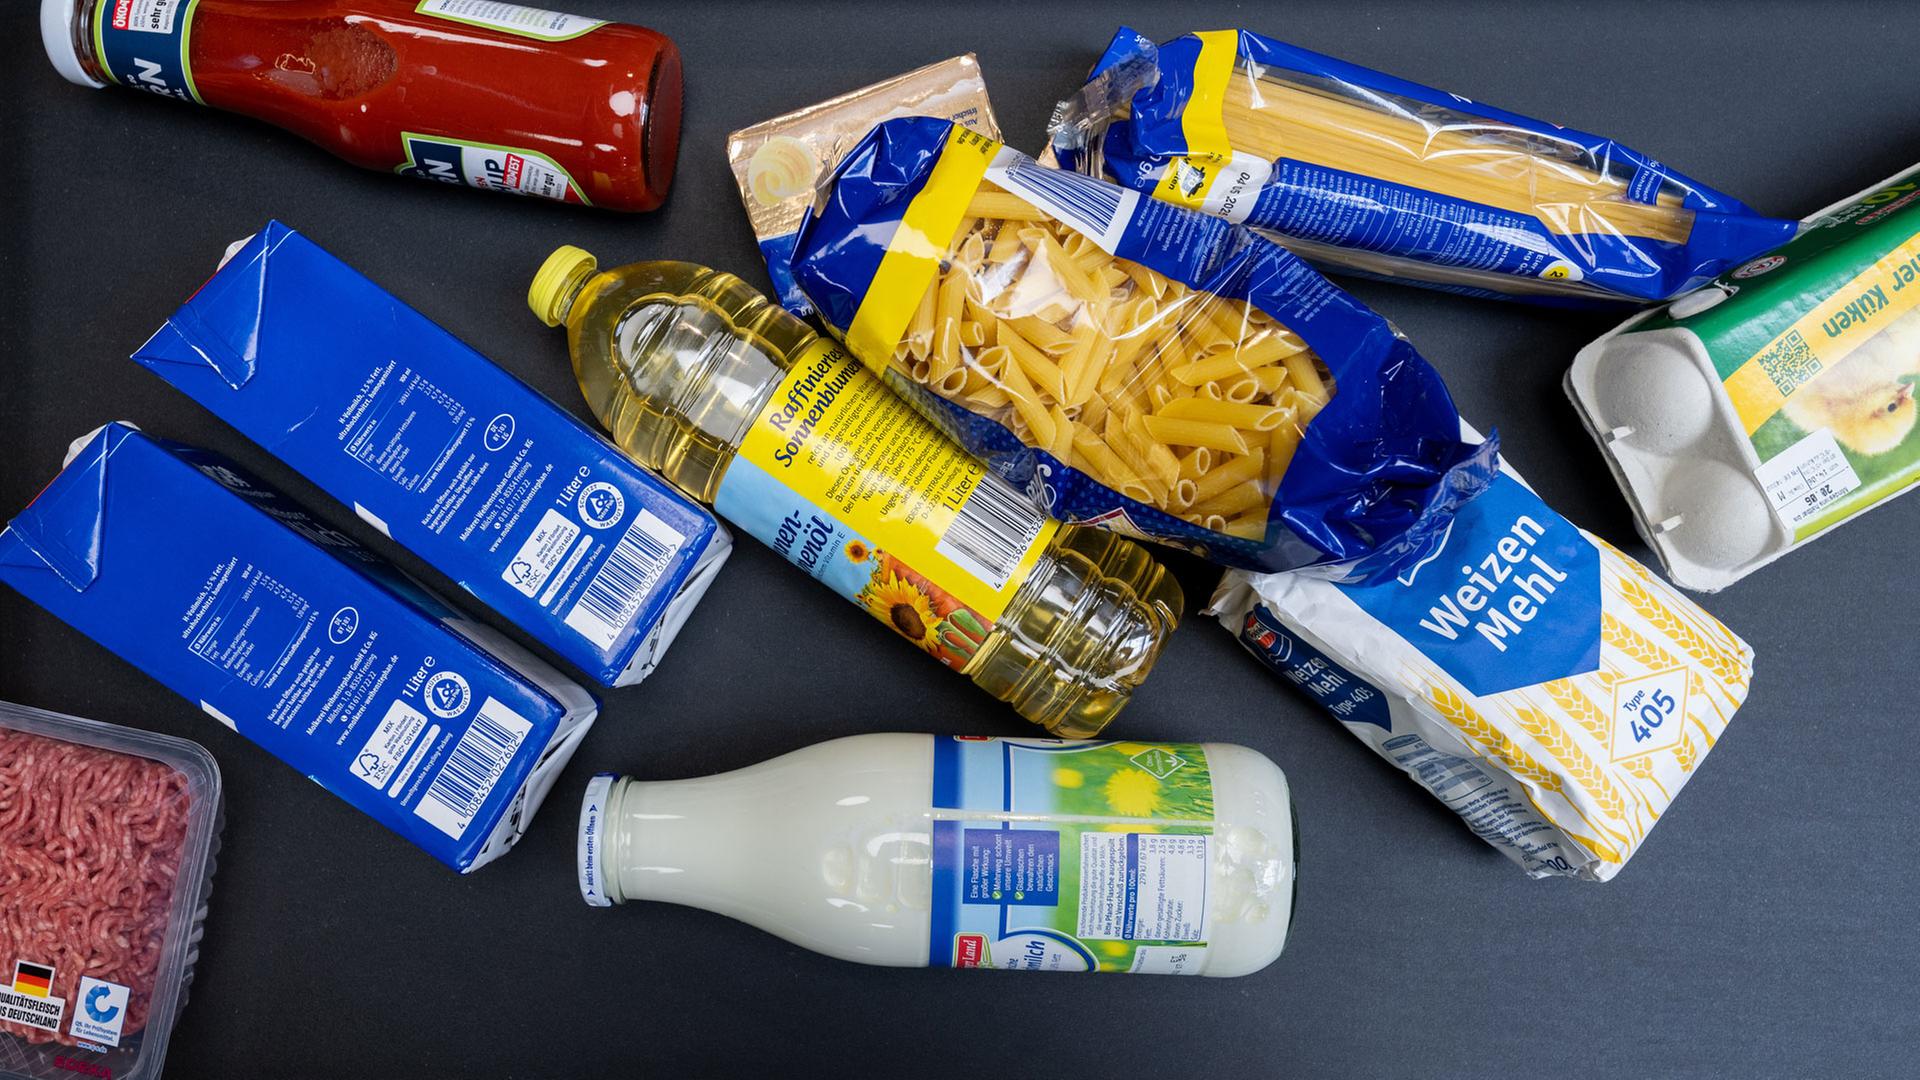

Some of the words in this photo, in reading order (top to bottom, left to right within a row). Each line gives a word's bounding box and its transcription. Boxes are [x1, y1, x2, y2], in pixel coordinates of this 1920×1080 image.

[150, 8, 161, 28] sehr
[1235, 171, 1250, 185] 04
[1821, 283, 1889, 339] Küken
[768, 343, 841, 432] Raffiniertes
[338, 391, 364, 425] H-Vollmilch,
[523, 438, 534, 448] KG
[819, 431, 831, 444] an
[515, 454, 523, 462] &
[518, 446, 528, 457] Co.
[503, 459, 520, 479] GmbH
[877, 475, 894, 495] Nicht
[889, 457, 906, 477] über
[901, 444, 915, 460] 175
[475, 475, 509, 520] Weihenstephan
[479, 507, 498, 531] Milchstr.
[514, 460, 532, 483] Freising
[559, 474, 584, 502] Liter
[904, 499, 925, 524] EDEKA
[919, 469, 945, 502] ZENTRALE
[947, 474, 973, 504] Liter
[1776, 490, 1785, 500] M
[1804, 483, 1832, 506] 20.06
[488, 461, 555, 554] www.molkerei-weihenstephan.de
[555, 498, 567, 508] 1
[612, 508, 623, 521] GUT
[942, 502, 954, 512] 1
[459, 515, 480, 542] Molkerei
[534, 528, 547, 543] MIX
[525, 568, 542, 588] FSC
[992, 580, 1002, 590] 4
[1418, 515, 1545, 639] Weizen
[605, 631, 615, 641] 4
[614, 589, 645, 629] 008452
[641, 550, 672, 590] 027602
[1474, 553, 1565, 652] Mehl
[362, 638, 373, 649] Co.
[367, 630, 378, 640] KG
[348, 651, 364, 671] GmbH
[359, 646, 367, 654] &
[321, 668, 355, 713] Weihenstephan
[405, 664, 429, 692] Liter
[1307, 670, 1347, 697] Mehl
[335, 653, 400, 747] www.molkerei-weihenstephan.de
[401, 689, 413, 699] 1
[1327, 698, 1354, 715] Type
[1349, 684, 1374, 702] 405
[1622, 689, 1645, 712] Type
[305, 709, 326, 736] Molkerei
[382, 719, 395, 734] MIX
[1630, 688, 1673, 742] 405
[373, 760, 389, 780] FSC
[455, 820, 466, 830] 4
[463, 777, 494, 817] 008452
[489, 737, 520, 777] 027602
[585, 815, 595, 834] Öffnen
[994, 833, 1002, 856] schont
[1004, 839, 1012, 865] Umwelt
[1108, 838, 1116, 875] ausgespült
[1140, 851, 1146, 859] 67
[970, 857, 979, 883] Flasche
[980, 847, 991, 876] Wirkung:
[1016, 848, 1025, 890] Glasflaschen
[1046, 852, 1055, 891] Geschmack
[1117, 836, 1125, 882] zurückgeben.
[993, 858, 1003, 890] Mehrweg
[1004, 867, 1012, 890] unsere
[1025, 857, 1034, 891] bewahren
[1036, 854, 1045, 891] natürlichen
[970, 884, 978, 898] Eine
[981, 878, 990, 898] großer
[1104, 877, 1114, 921] Pfand-Flasche
[1115, 883, 1123, 914] Verschluß
[1127, 891, 1135, 902] pro
[1103, 922, 1111, 935] Bitte
[1124, 903, 1135, 932] Nährwerte
[963, 939, 977, 960] Land
[7, 1007, 58, 1029] DEUTSCHLAND
